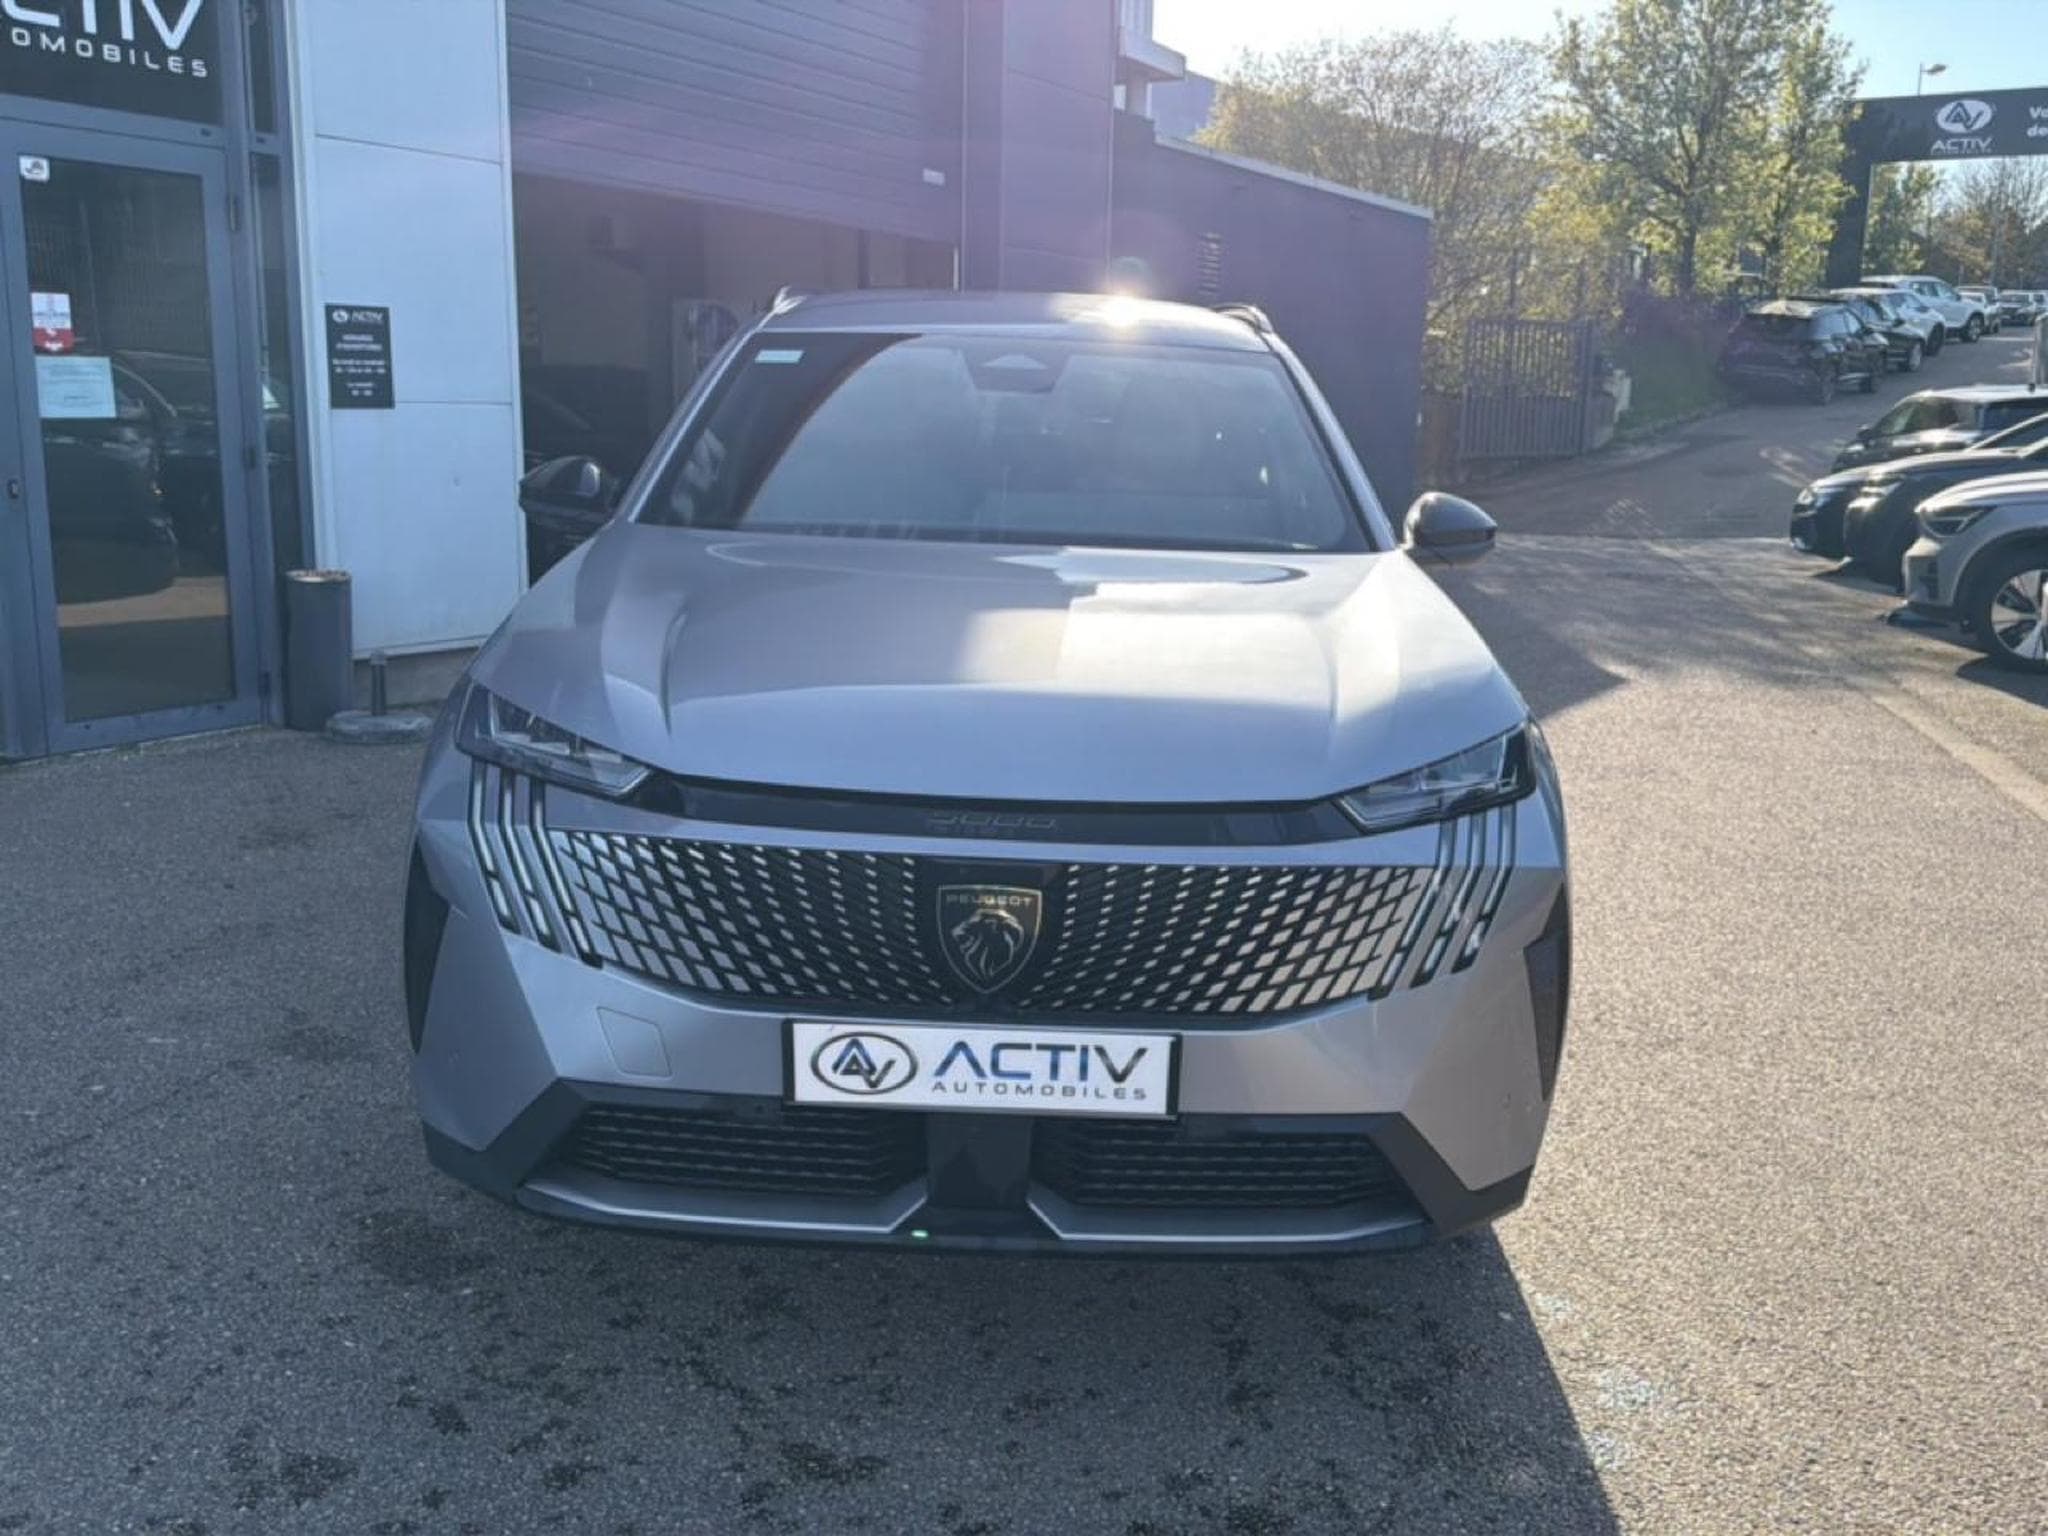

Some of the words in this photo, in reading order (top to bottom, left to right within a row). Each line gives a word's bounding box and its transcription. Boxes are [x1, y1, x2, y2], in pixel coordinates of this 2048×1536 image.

[946, 894, 1033, 907] PEUGEOT
[933, 1040, 1148, 1084] ACTIV
[931, 1081, 1147, 1101] AUTOMOBILES
